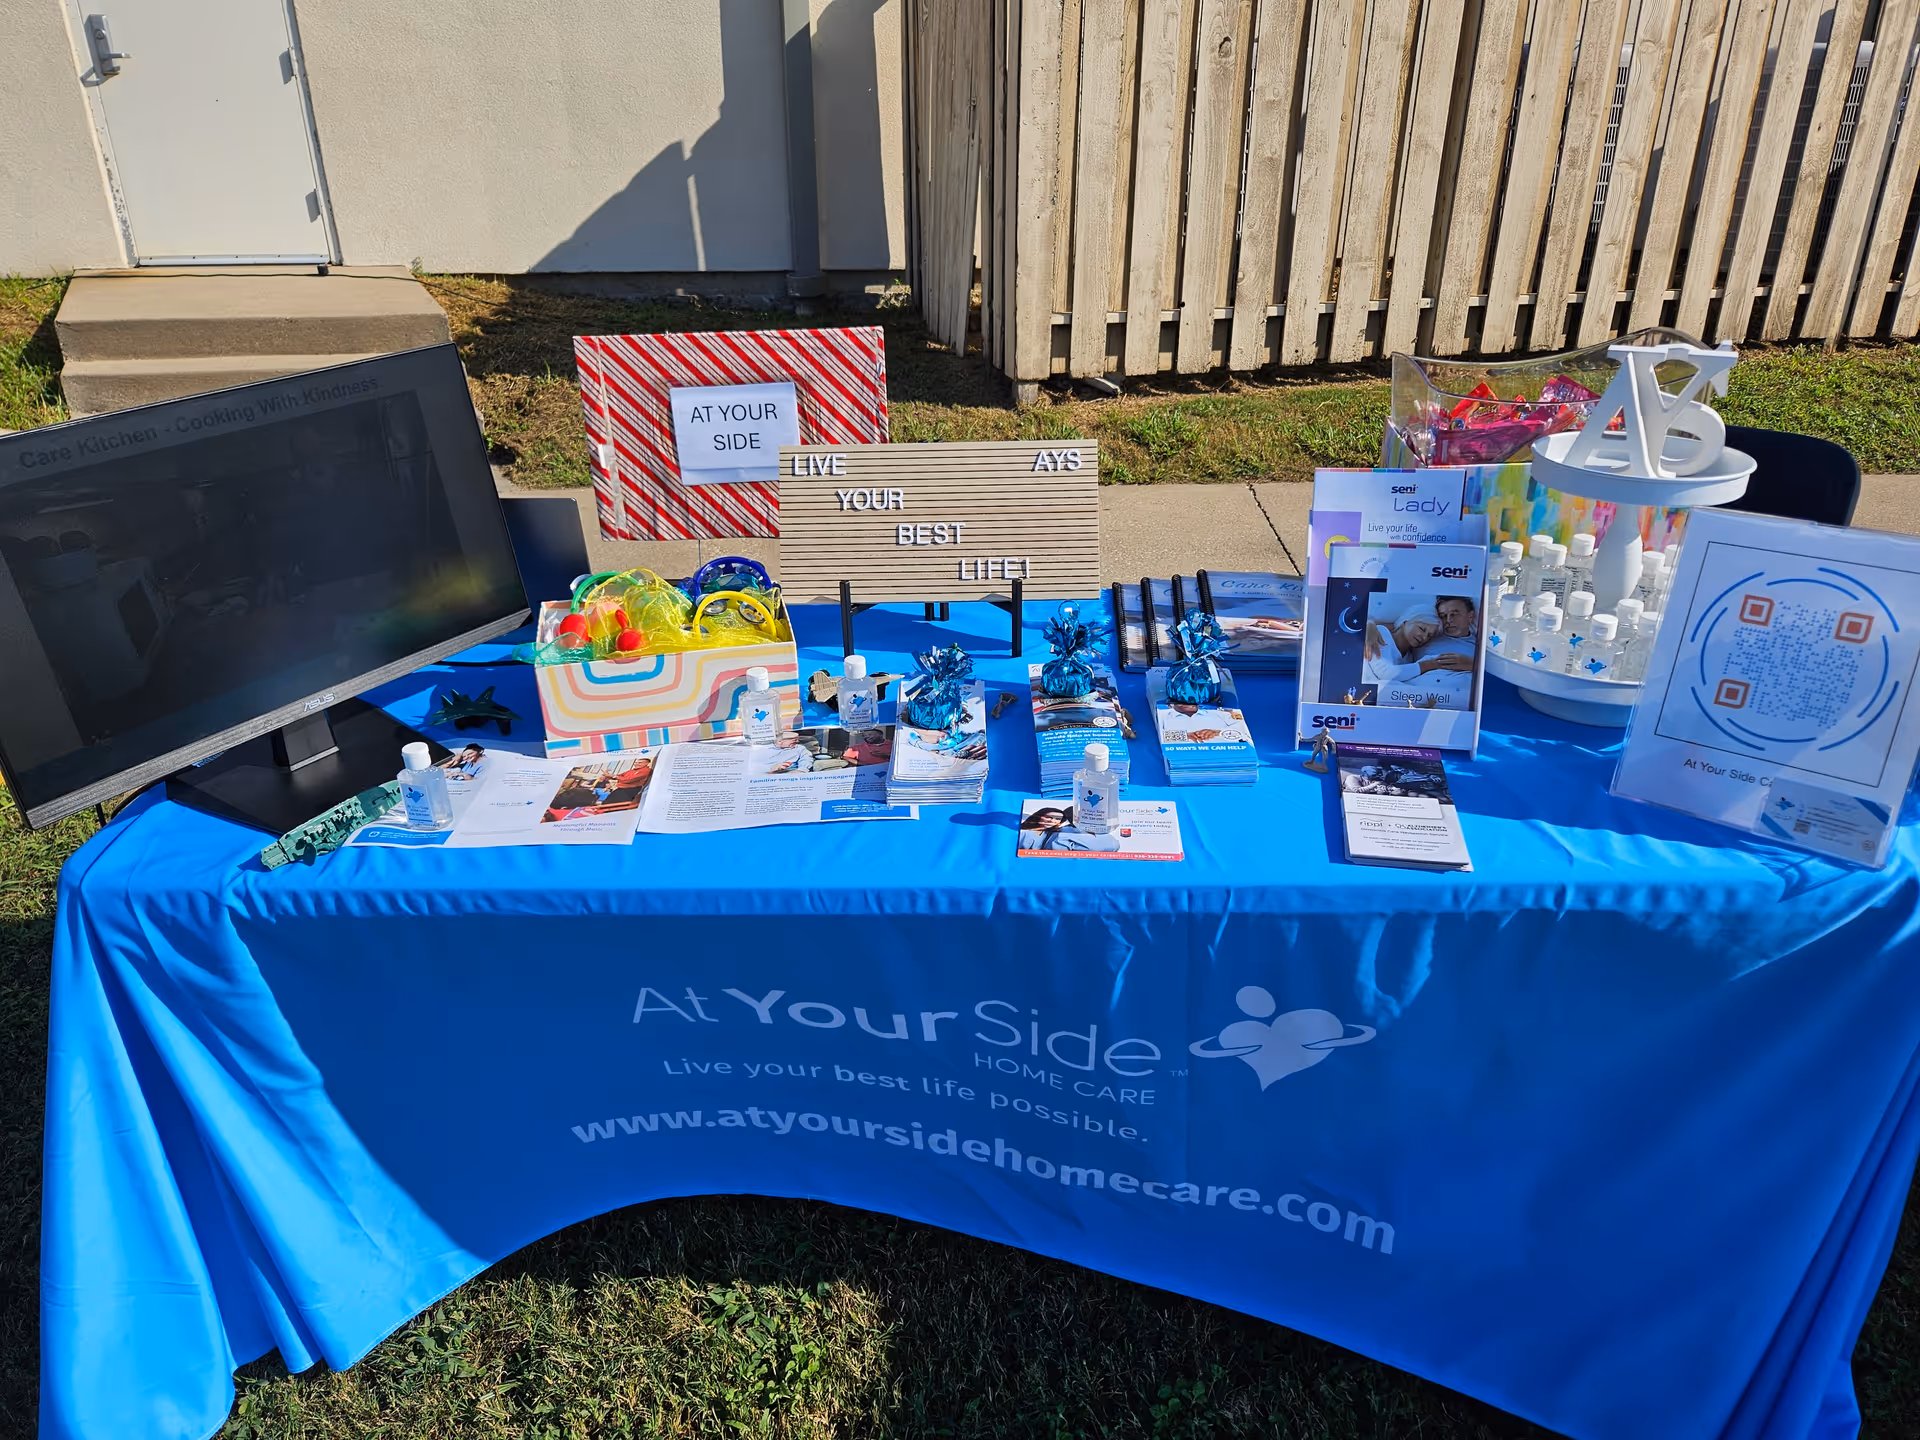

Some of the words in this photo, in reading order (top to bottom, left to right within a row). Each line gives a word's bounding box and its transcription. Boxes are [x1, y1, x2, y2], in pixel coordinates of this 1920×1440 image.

[19, 447, 73, 469] Care
[77, 427, 158, 457] Kitchen
[175, 405, 255, 435] Cooking
[258, 393, 299, 416] With
[303, 376, 381, 407] Kindness
[691, 405, 713, 423] AT
[718, 403, 778, 421] YOUR
[713, 432, 761, 451] SIDE
[792, 454, 848, 476] LIVE
[1032, 449, 1082, 472] AYS
[836, 488, 904, 510] YOUR
[1391, 484, 1417, 494] seni
[1393, 497, 1450, 516] Lady
[897, 522, 966, 545] BEST
[1368, 523, 1384, 532] Live
[1386, 525, 1403, 533] your
[1405, 523, 1418, 533] life
[1402, 532, 1447, 543] confidence
[958, 557, 1030, 581] LIFE!
[1431, 565, 1469, 579] seni
[304, 693, 335, 712] ASUS
[1390, 690, 1423, 704] Sleep
[1426, 691, 1451, 704] Well
[1312, 713, 1356, 729] seni
[1683, 758, 1697, 769] At
[1700, 761, 1726, 776] Your
[1729, 768, 1756, 784] Side
[633, 987, 719, 1023] At
[721, 987, 959, 1041] Your
[974, 1000, 1161, 1077] Side
[974, 1052, 1063, 1090] HOME
[1073, 1081, 1156, 1105] CARE
[663, 1058, 733, 1076] Live
[743, 1061, 823, 1078] your
[834, 1065, 911, 1092] best
[922, 1077, 976, 1101] life
[990, 1091, 1149, 1142] possible.
[571, 1106, 1396, 1255] www.atyoursidehomecare.com
